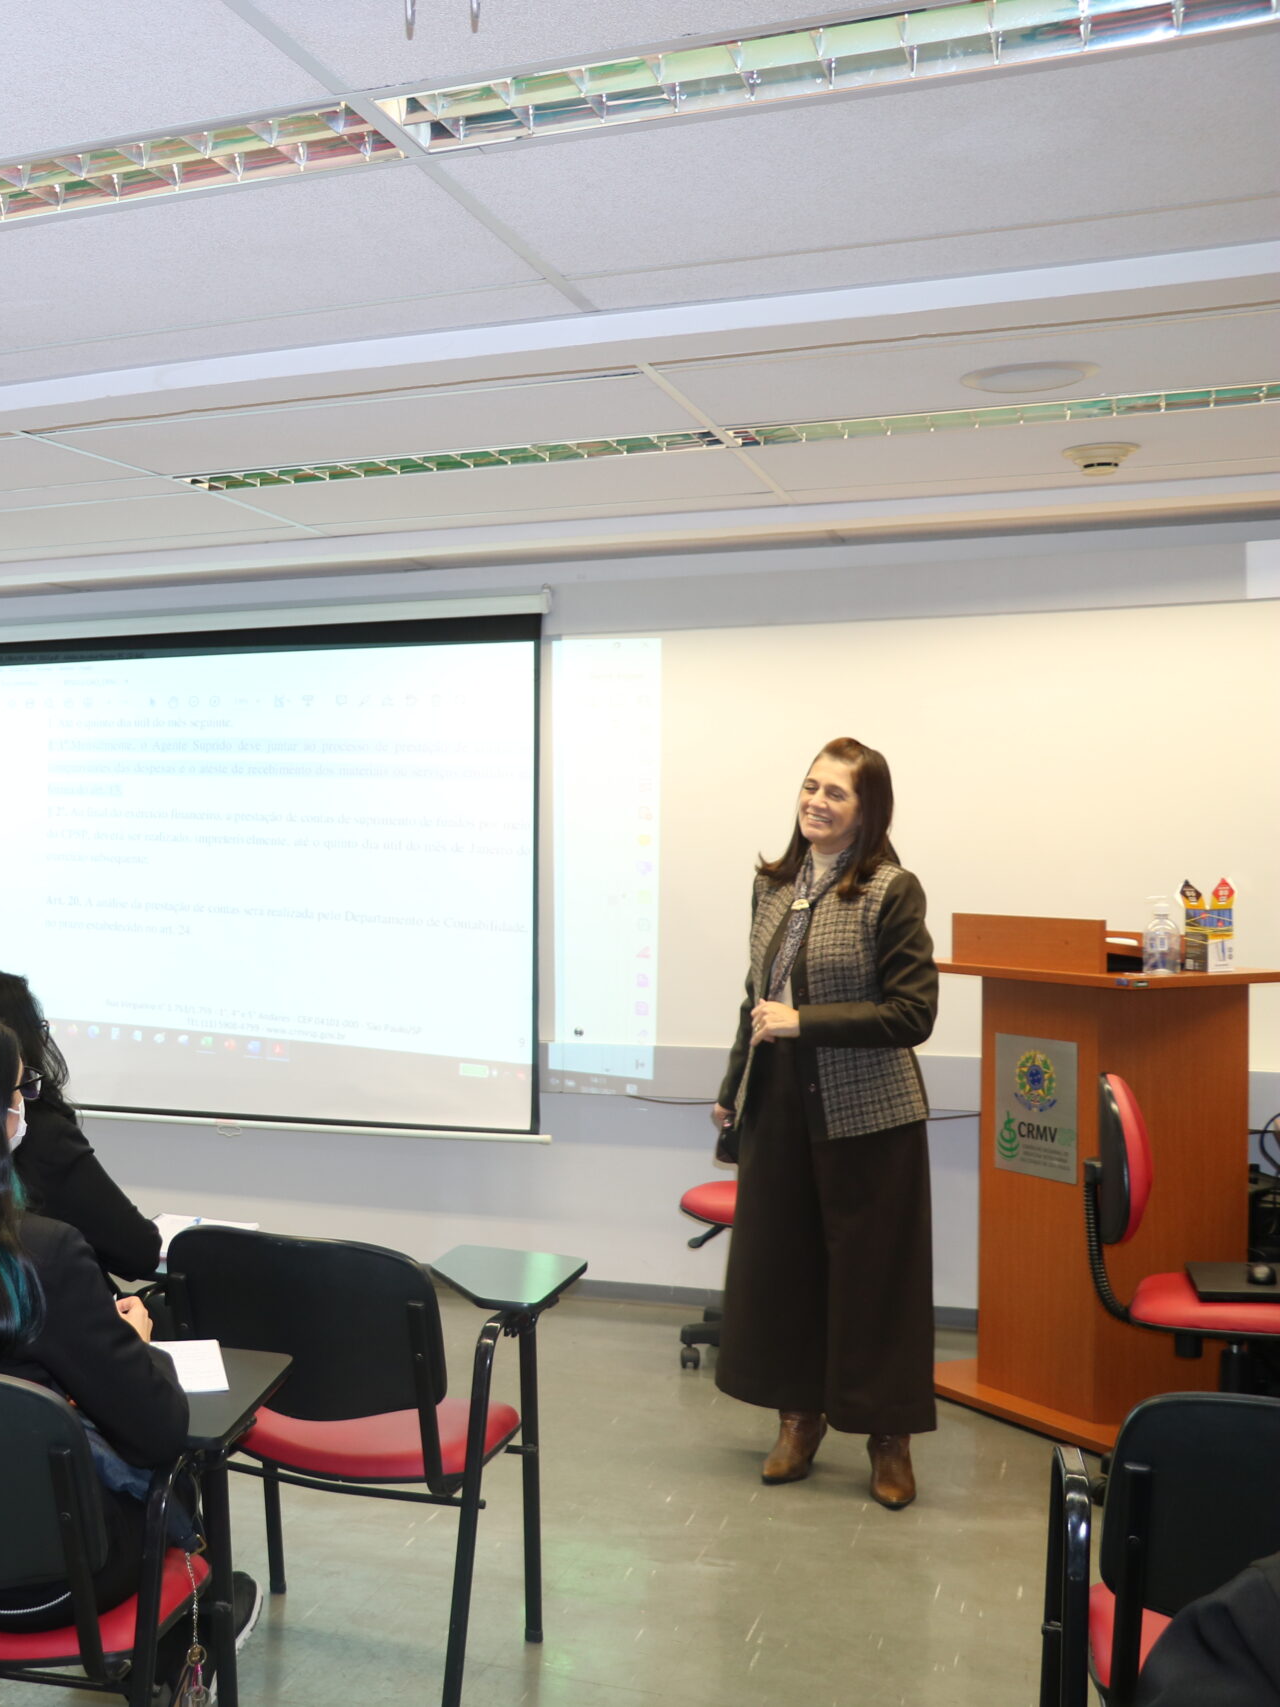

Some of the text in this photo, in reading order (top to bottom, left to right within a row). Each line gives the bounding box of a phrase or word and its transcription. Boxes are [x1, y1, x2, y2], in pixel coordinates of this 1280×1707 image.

[116, 717, 132, 728] dia
[152, 717, 165, 728] do
[168, 717, 186, 728] mês
[151, 740, 187, 753] Agente
[192, 740, 232, 753] Suprido
[238, 740, 261, 752] deve
[266, 741, 298, 754] juntar
[304, 744, 316, 752] ao
[322, 743, 370, 754] processo
[376, 741, 388, 752] de
[393, 741, 450, 756] prestação
[134, 762, 176, 776] despesas
[199, 764, 228, 774] ateste
[231, 763, 244, 774] de
[247, 763, 312, 776] recebimento
[316, 764, 334, 775] dos
[393, 767, 408, 776] ou
[86, 806, 108, 817] final
[110, 807, 122, 818] do
[234, 811, 283, 824] prestação
[286, 811, 298, 823] de
[300, 814, 335, 824] contas
[338, 813, 350, 825] de
[420, 816, 432, 828] de
[46, 828, 58, 839] do
[127, 833, 140, 841] ser
[294, 836, 308, 847] até
[323, 838, 358, 851] quinto
[361, 839, 379, 851] dia
[406, 840, 420, 852] do
[424, 841, 447, 853] mês
[451, 841, 464, 853] de
[46, 896, 65, 905] Art.
[84, 896, 93, 907] A
[96, 897, 128, 908] análise
[131, 898, 142, 909] da
[144, 900, 190, 914] prestação
[193, 901, 205, 912] de
[207, 904, 240, 914] contas
[267, 907, 314, 919] realizada
[317, 910, 341, 922] pelo
[344, 911, 423, 927] Departamento
[426, 916, 440, 928] de
[44, 920, 56, 928] no
[58, 920, 84, 931] prazo
[86, 920, 143, 933] estabelecido
[145, 924, 158, 934] no
[1017, 1121, 1058, 1144] CRMV
